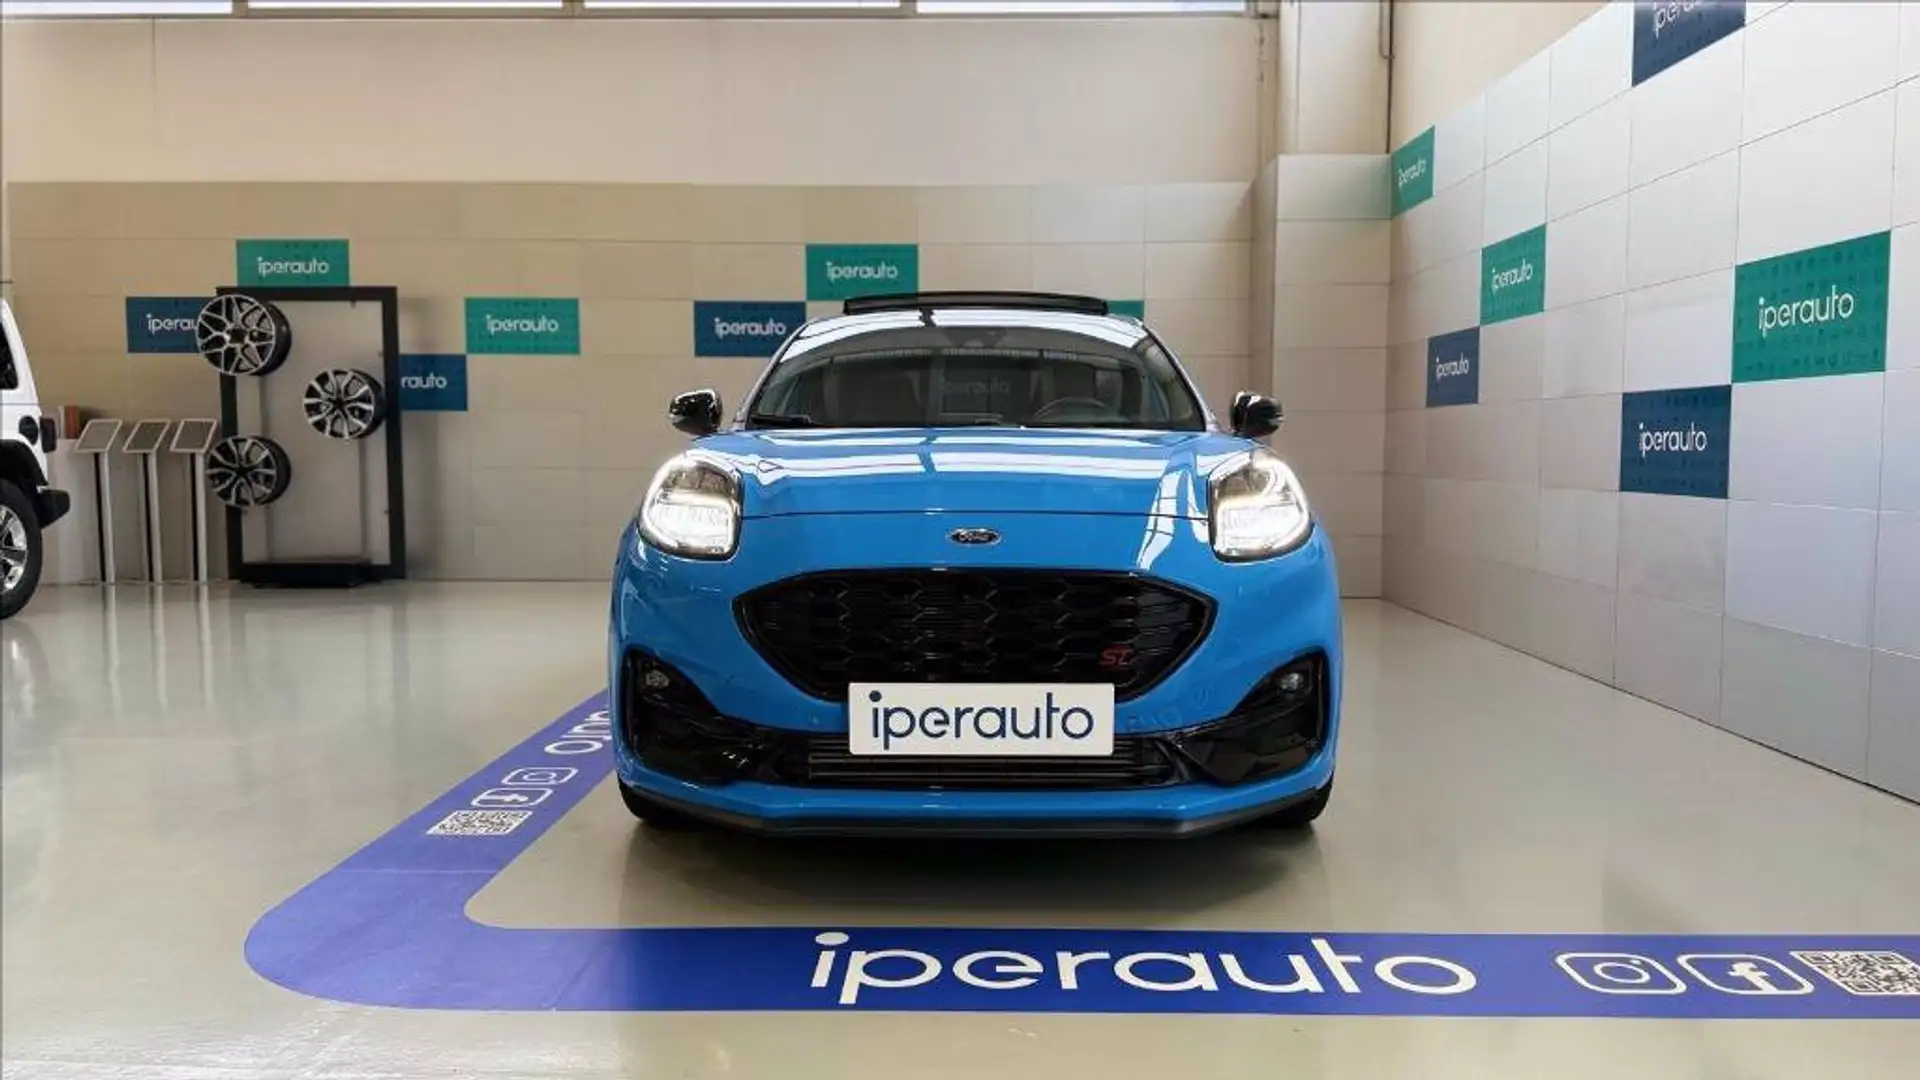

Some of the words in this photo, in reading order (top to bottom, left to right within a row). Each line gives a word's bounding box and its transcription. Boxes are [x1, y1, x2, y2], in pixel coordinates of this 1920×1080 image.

[1398, 158, 1427, 187] iperauto
[256, 256, 329, 276] iperauto
[826, 261, 899, 281] iperauto
[1491, 258, 1534, 298] iperauto
[486, 314, 560, 335] iperauto
[1757, 284, 1855, 338] iperauto
[714, 317, 787, 338] iperauto
[1435, 352, 1470, 380] iperauto
[1639, 422, 1708, 457] iperauto
[868, 690, 1095, 750] iperauto
[810, 931, 1478, 1004] iperauto
